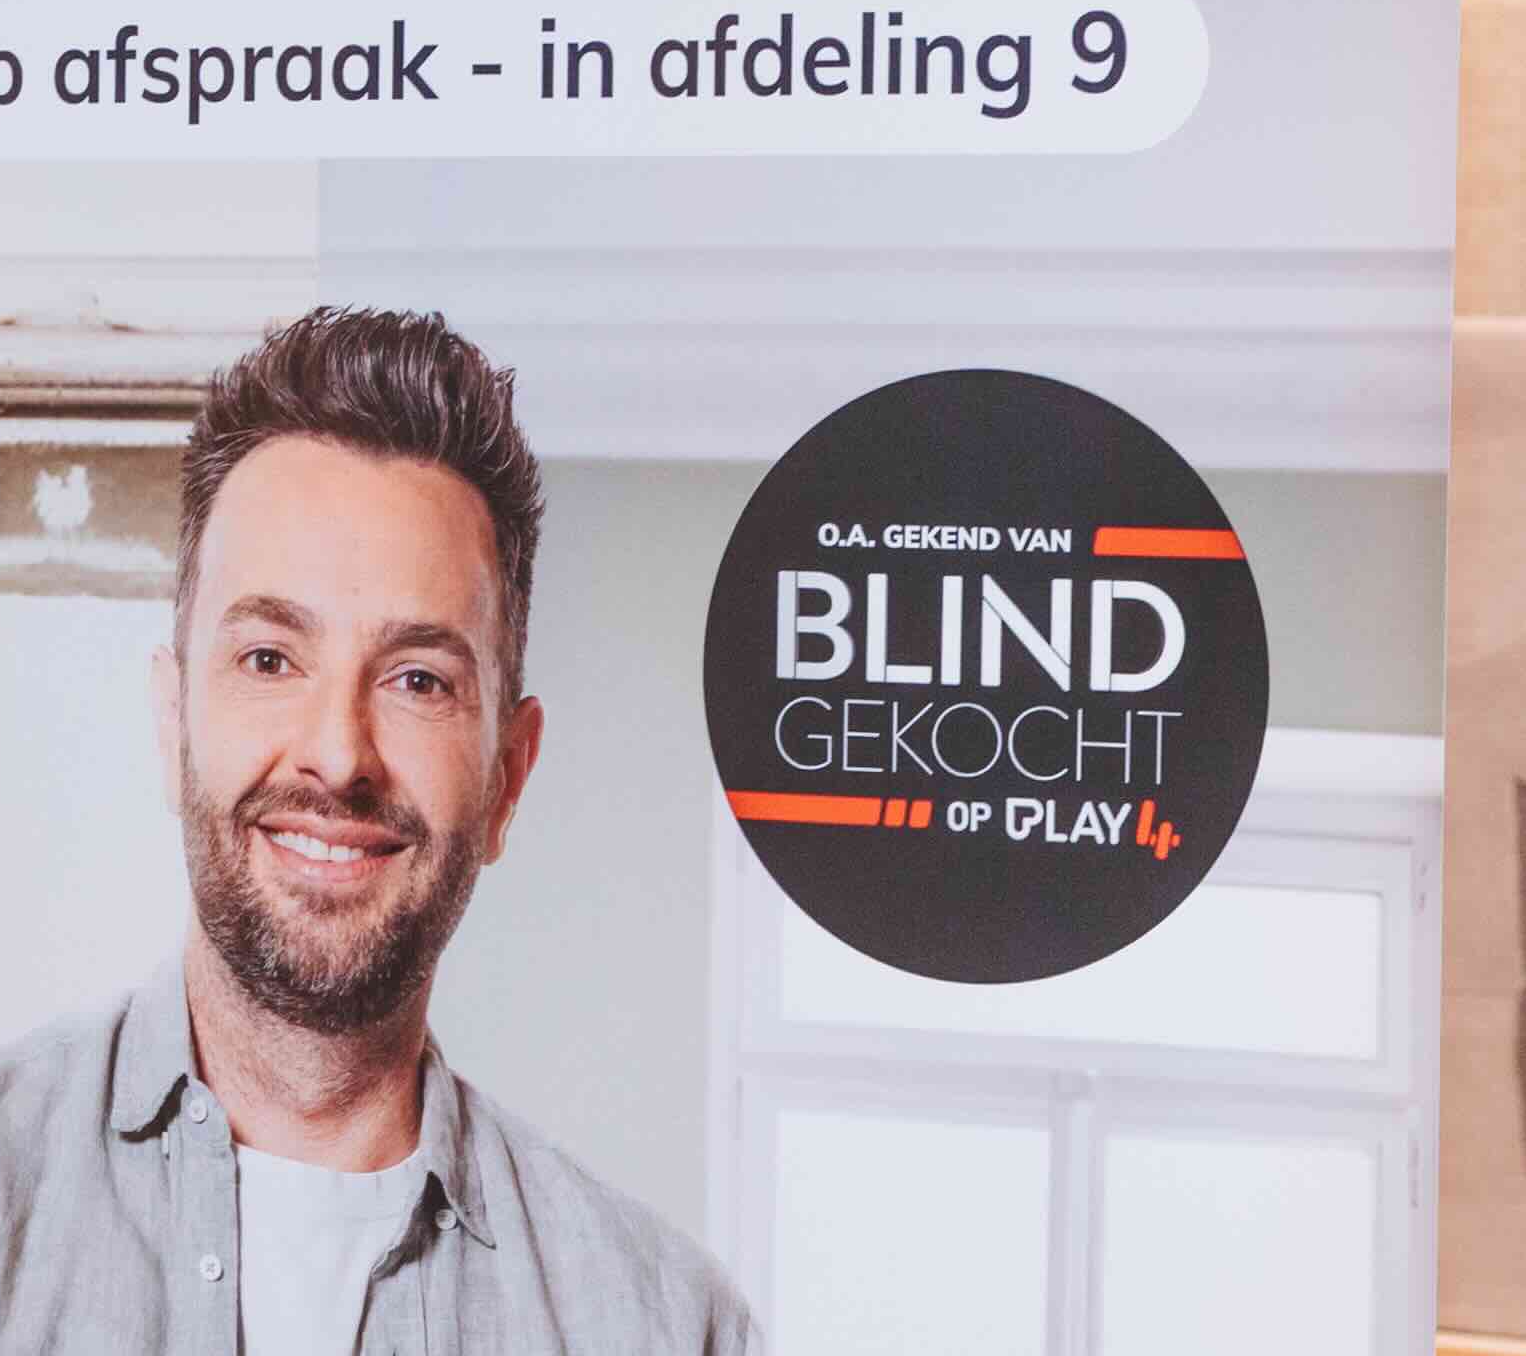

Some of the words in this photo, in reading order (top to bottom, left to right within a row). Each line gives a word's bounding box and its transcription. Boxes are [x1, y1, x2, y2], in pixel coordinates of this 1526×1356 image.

[53, 18, 440, 126] afspraak
[470, 62, 503, 77] -
[540, 16, 615, 100] in
[649, 10, 1033, 120] afdeling
[1070, 9, 1128, 95] 9
[817, 522, 875, 549] O.A.
[882, 524, 1002, 552] GEKEND
[1007, 527, 1073, 554] VAN
[775, 569, 1187, 694] BLIND
[773, 695, 1184, 786] GEKOCHT
[946, 799, 993, 833] OP
